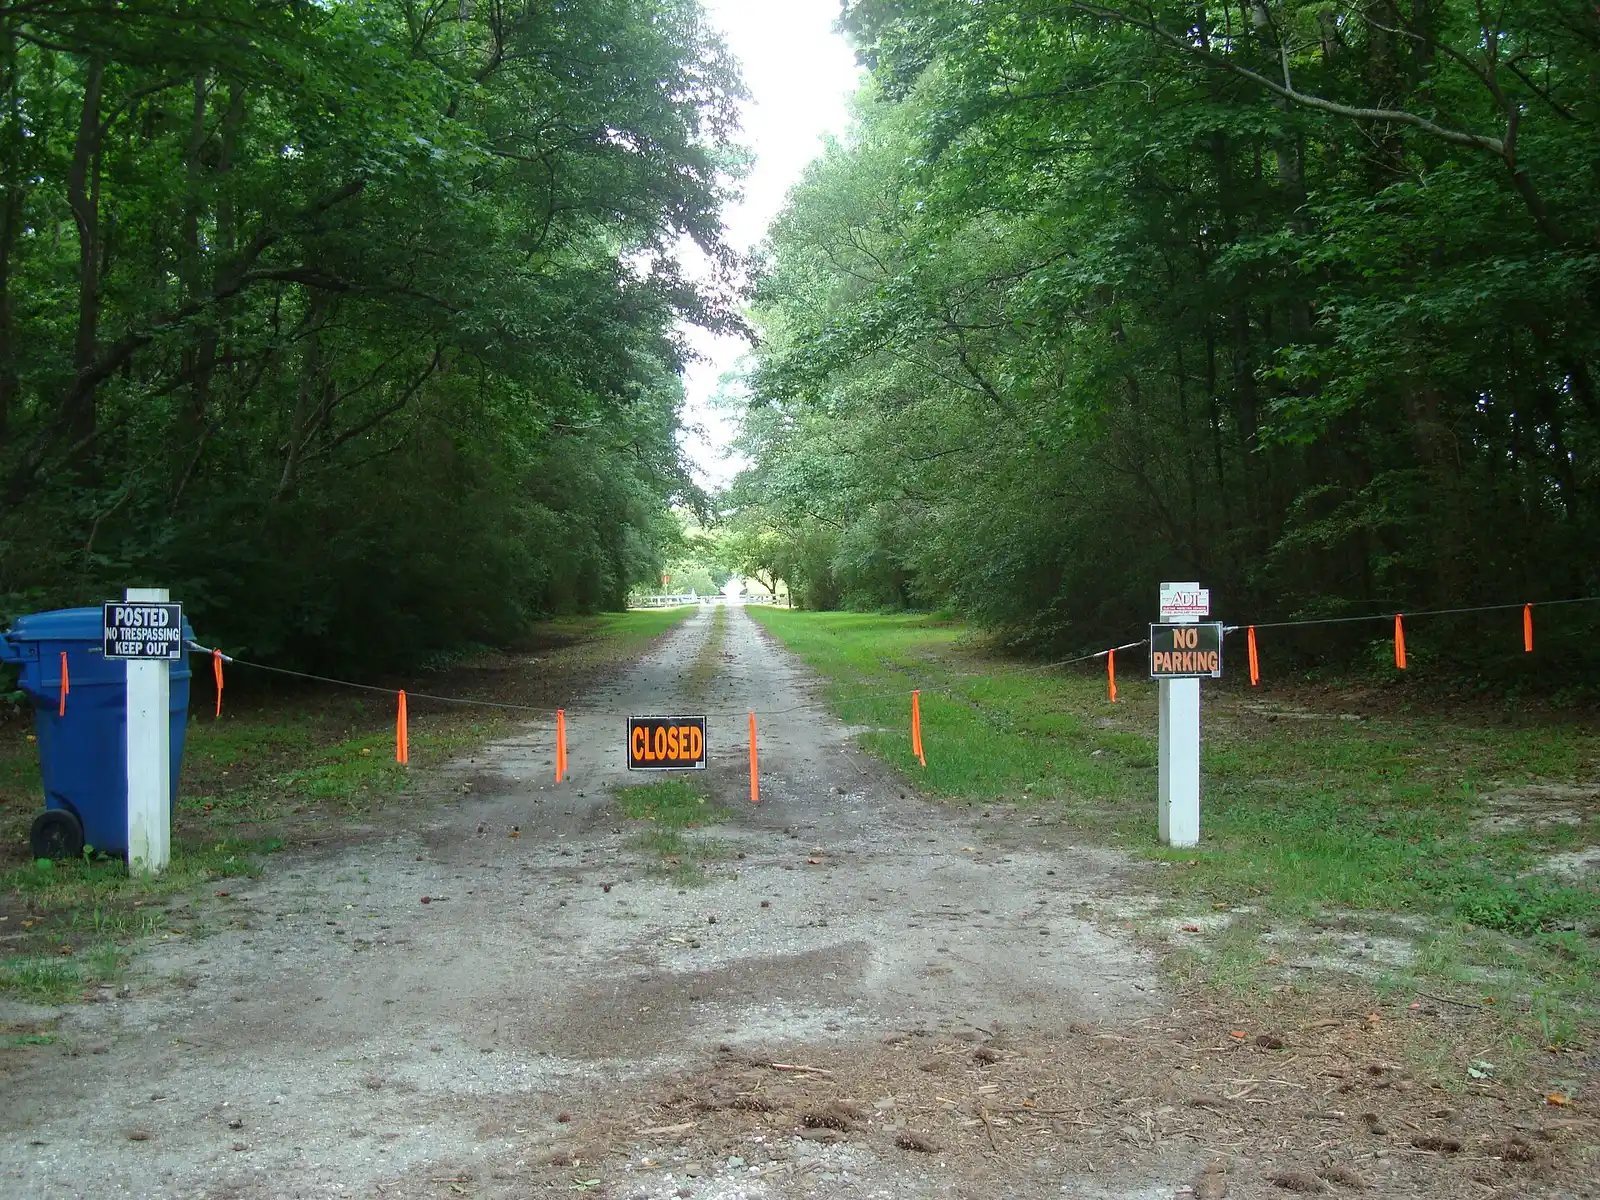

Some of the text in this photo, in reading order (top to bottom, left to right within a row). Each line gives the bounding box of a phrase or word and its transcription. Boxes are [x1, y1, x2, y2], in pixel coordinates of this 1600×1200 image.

[1170, 591, 1202, 606] ADT
[115, 607, 169, 627] POSTED
[105, 627, 179, 641] NO TRESPASSING
[1172, 627, 1198, 649] NO
[115, 641, 169, 655] KEEP OUT
[1153, 650, 1219, 672] PARKING
[631, 726, 703, 761] CLOSED
